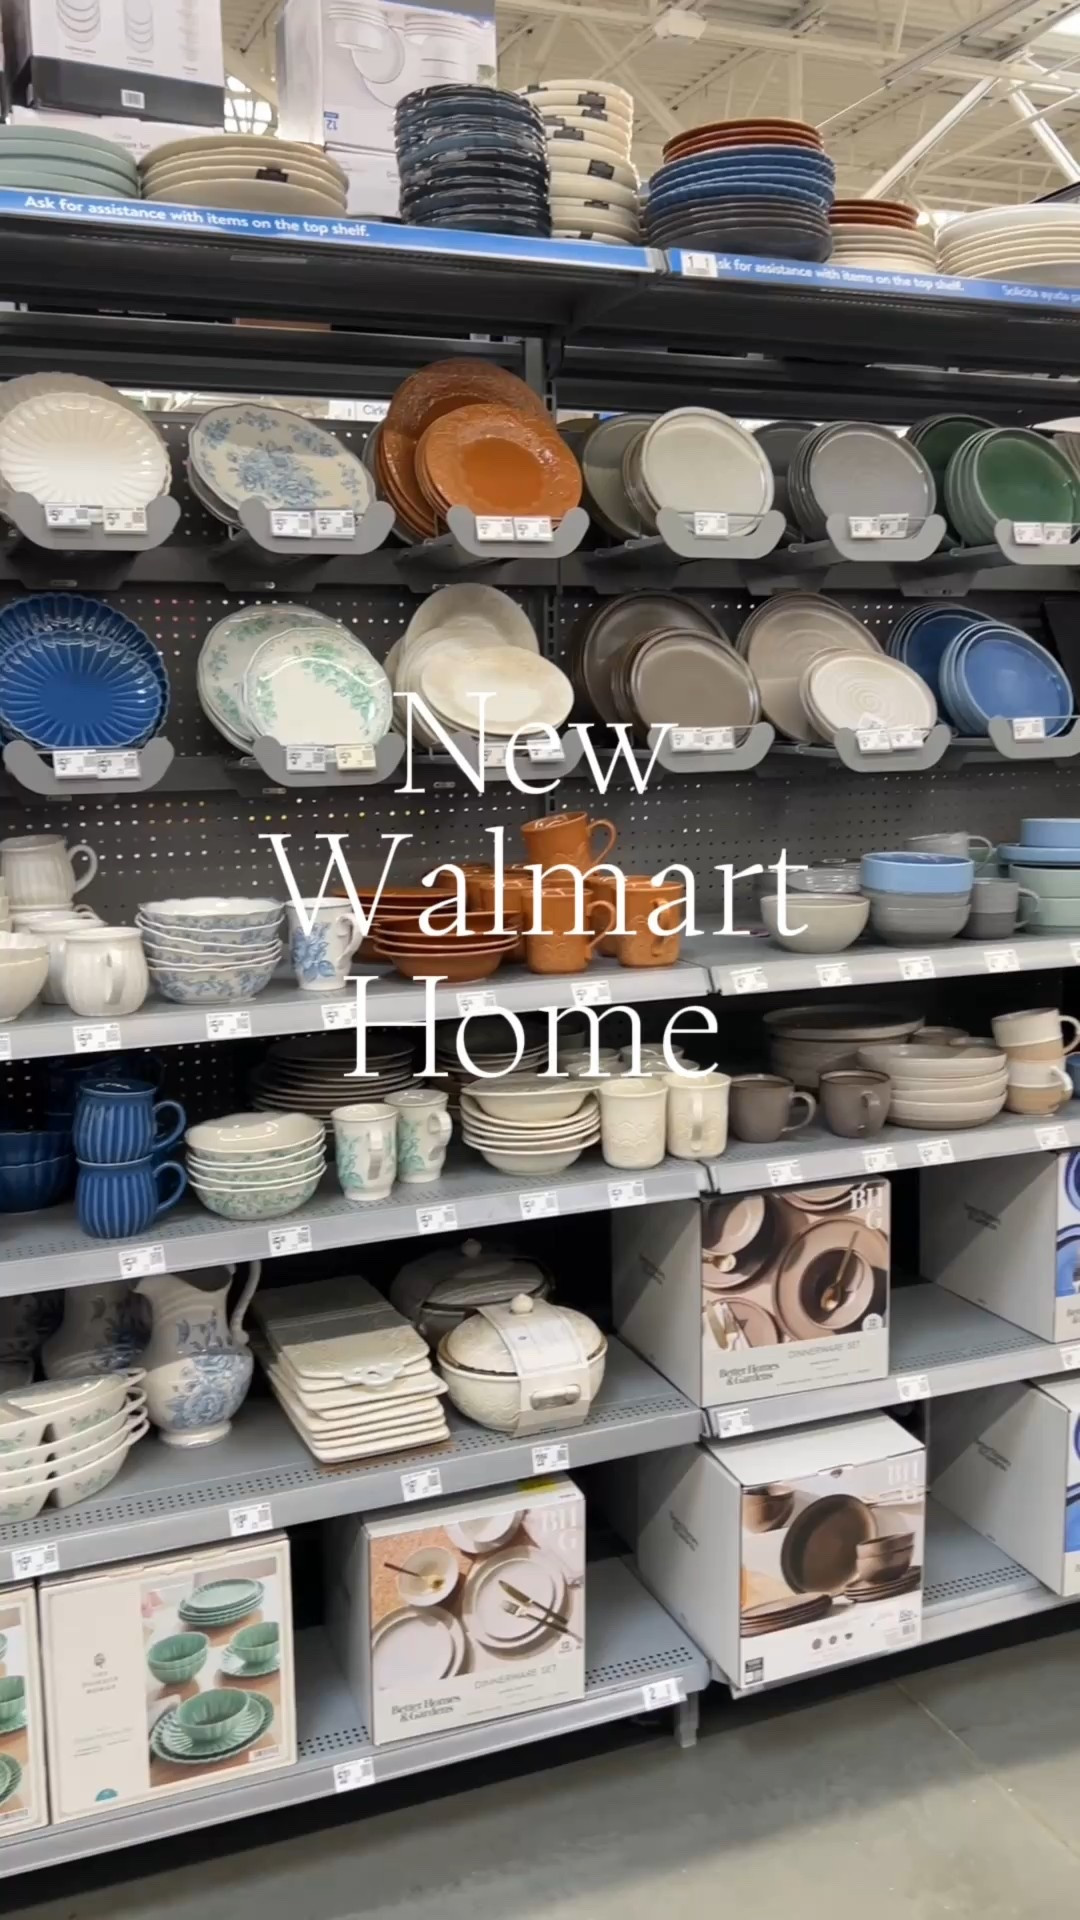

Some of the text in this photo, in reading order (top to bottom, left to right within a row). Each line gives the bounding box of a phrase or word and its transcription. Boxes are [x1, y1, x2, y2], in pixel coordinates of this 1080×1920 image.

[24, 195, 371, 238] Ask for assistance with items on the top shelf.
[718, 257, 732, 271] sk
[733, 258, 753, 272] for
[755, 264, 813, 278] assistance
[815, 268, 841, 280] with
[842, 270, 874, 284] items
[876, 275, 892, 285] on
[892, 274, 912, 288] the
[913, 277, 933, 291] top
[719, 1362, 780, 1379] Better Homes
[541, 1664, 557, 1675] SET
[391, 1695, 461, 1716] Better Homes
